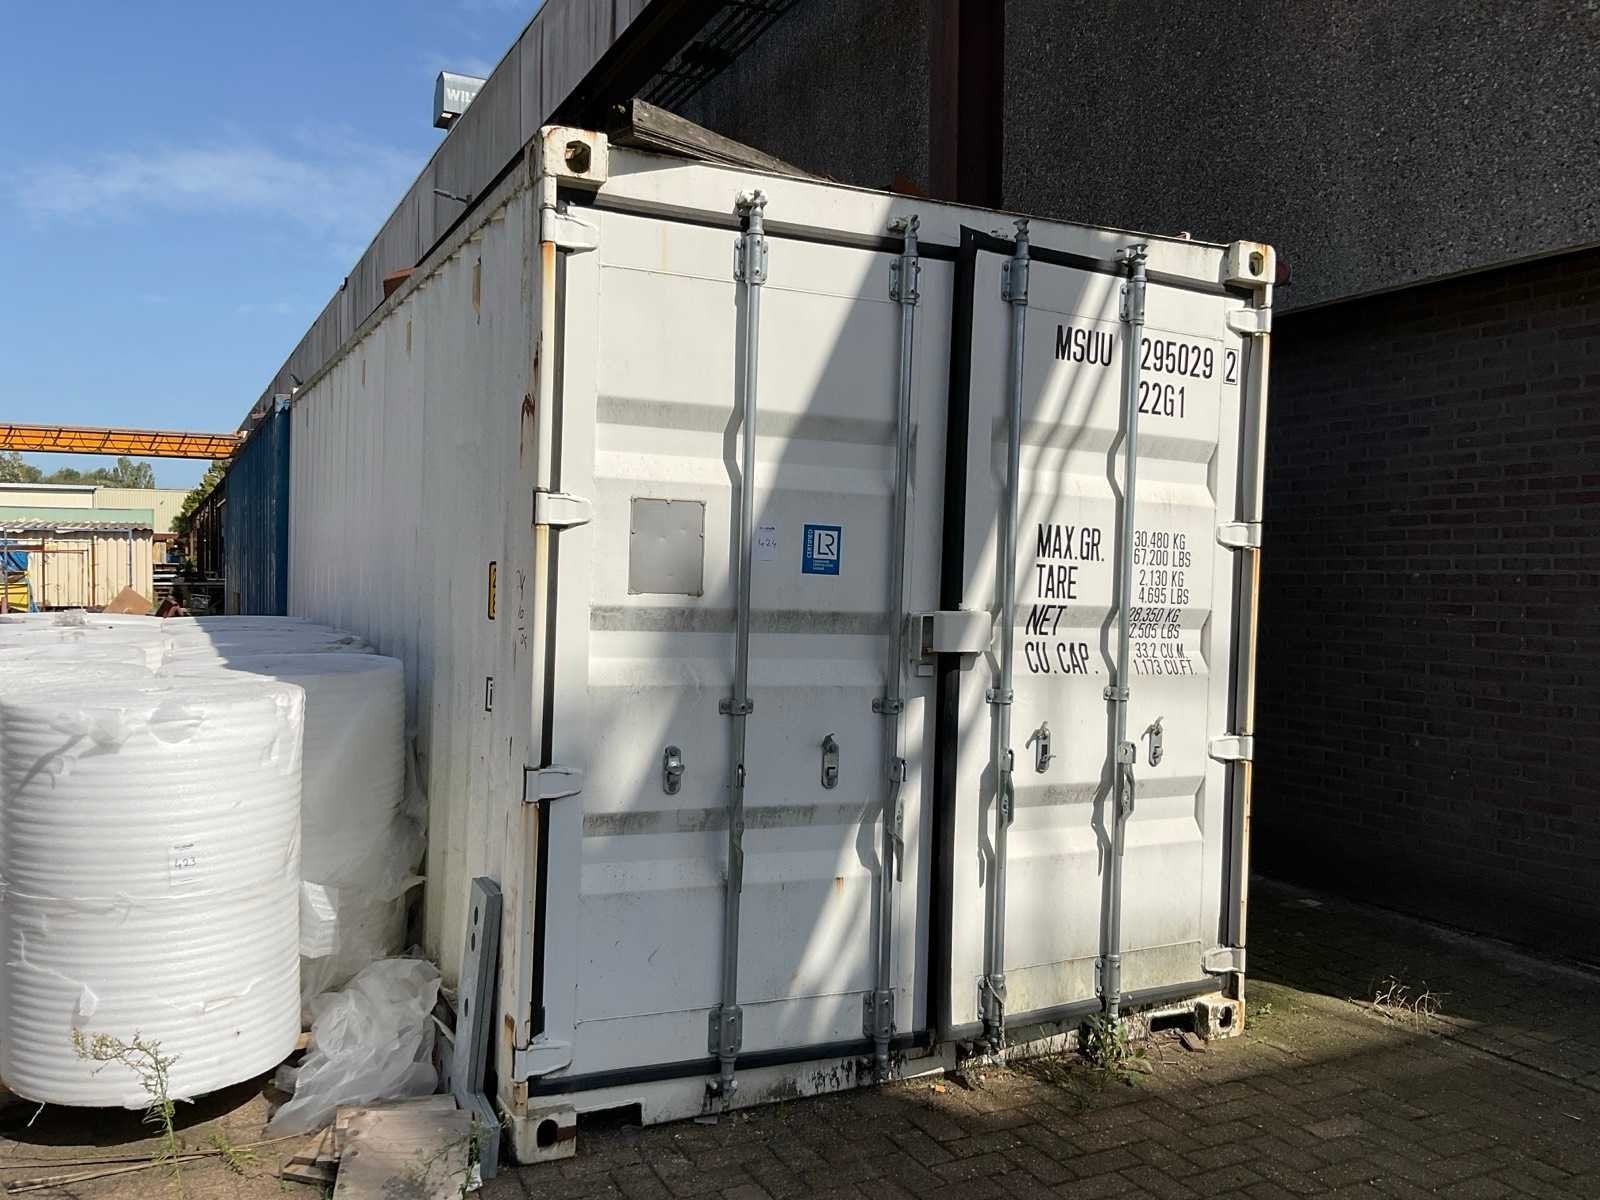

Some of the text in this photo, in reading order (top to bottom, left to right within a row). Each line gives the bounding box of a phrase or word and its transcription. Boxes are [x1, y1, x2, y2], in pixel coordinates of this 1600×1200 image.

[1055, 325, 1237, 383] MSUU 295029 2
[1138, 381, 1185, 418] 22G1
[1173, 533, 1186, 550] KG
[1172, 551, 1191, 568] LBS
[1036, 564, 1078, 600] TARE
[1171, 571, 1184, 588] KG
[1170, 588, 1189, 605] LBS
[1025, 604, 1067, 636] NET
[1165, 608, 1182, 623] KG
[1161, 624, 1181, 639] LBS
